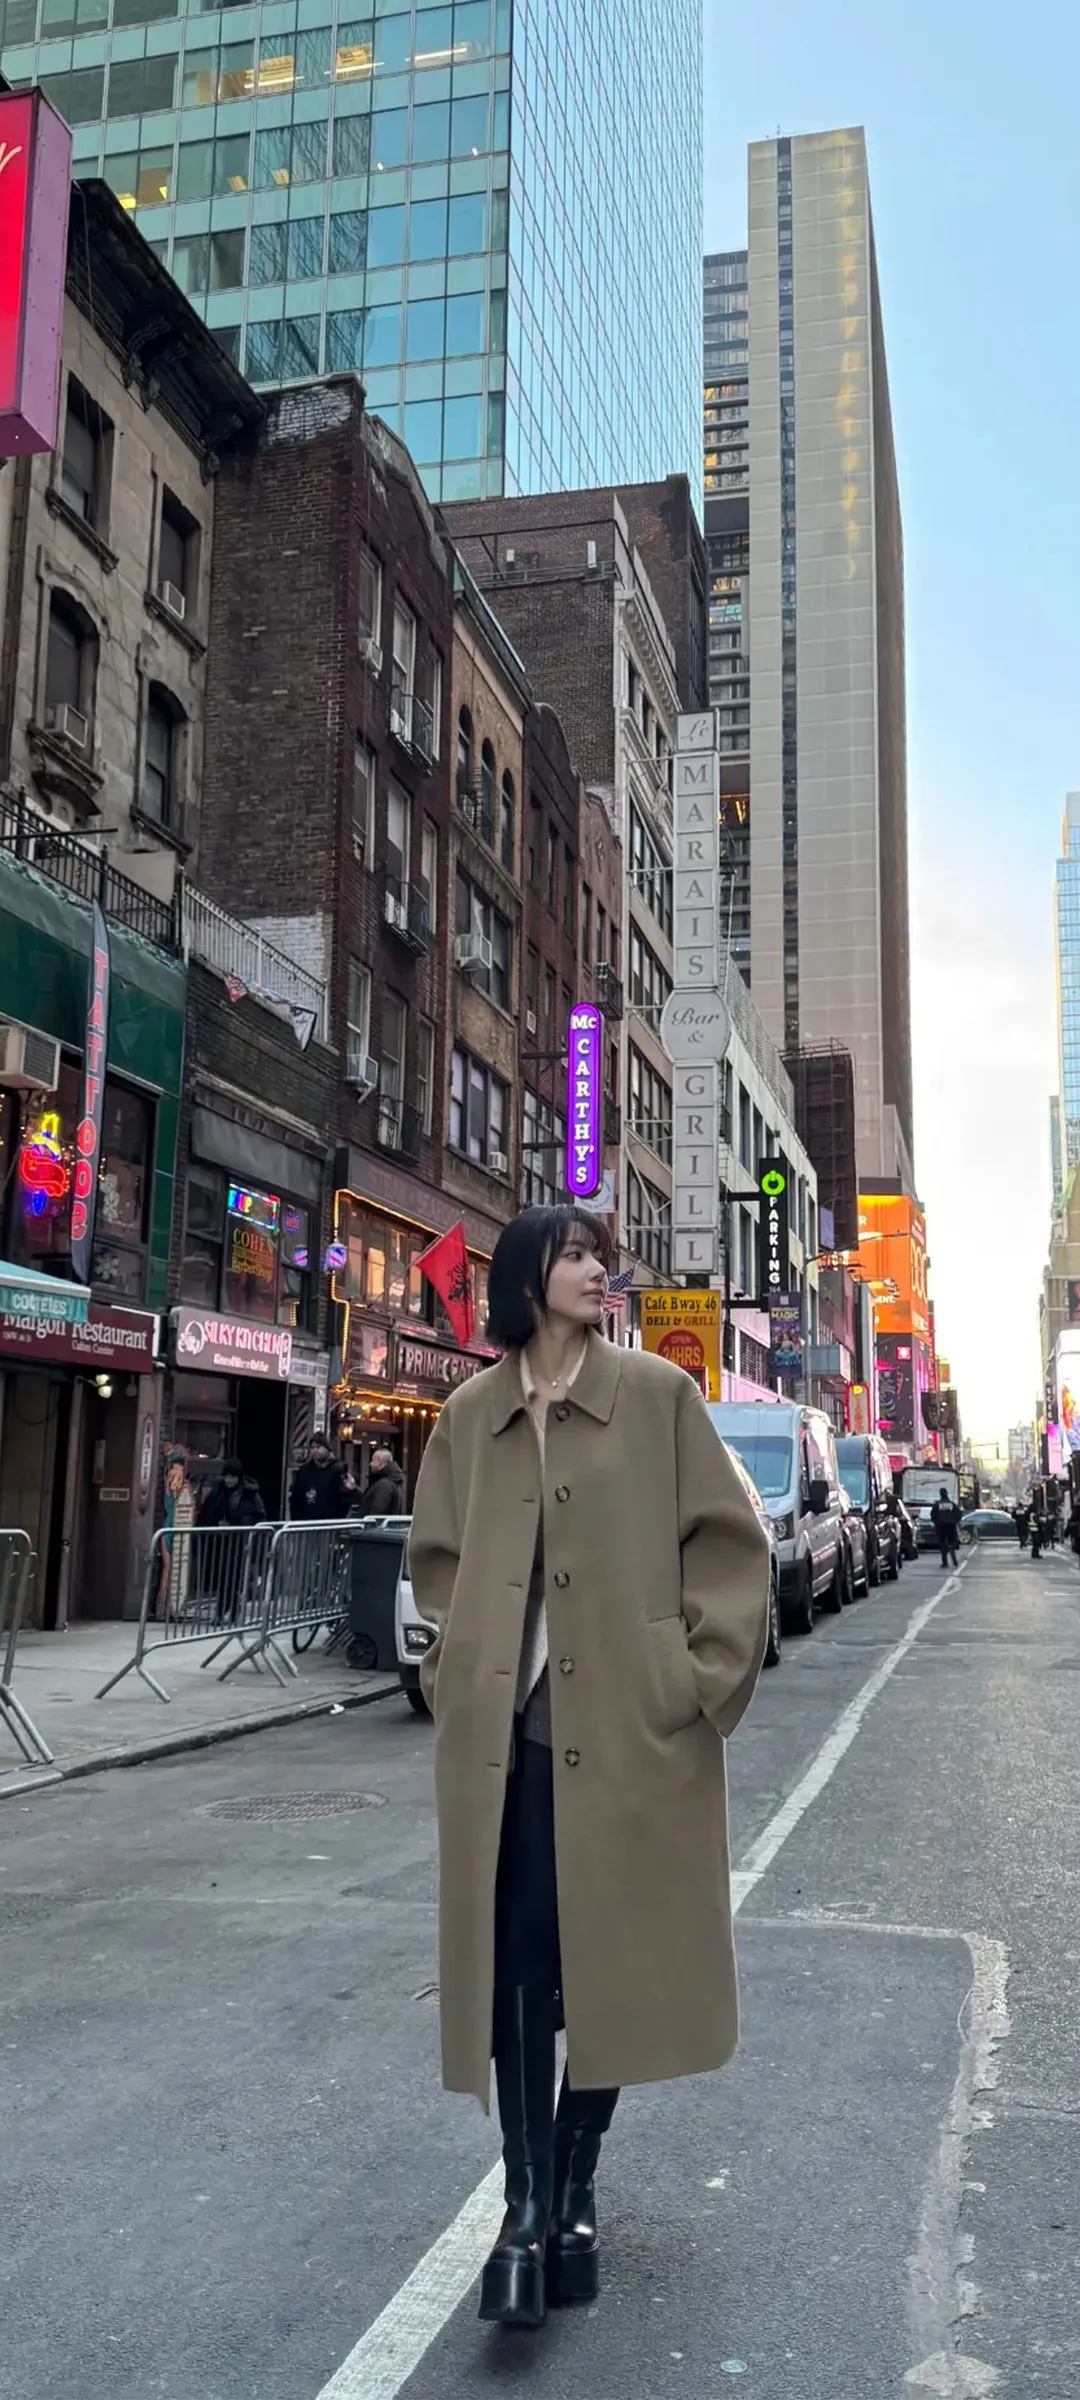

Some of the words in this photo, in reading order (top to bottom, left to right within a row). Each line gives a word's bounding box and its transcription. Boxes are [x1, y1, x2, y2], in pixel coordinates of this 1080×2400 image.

[680, 718, 709, 744] Le
[683, 762, 709, 976] MARAIS
[671, 1006, 720, 1027] Bar
[687, 1029, 704, 1044] &
[684, 1073, 706, 1262] GRILL
[768, 1196, 780, 1284] PARKING
[704, 1296, 717, 1310] 46
[646, 1316, 670, 1326] DELI
[673, 1316, 682, 1326] &
[684, 1316, 717, 1326] GRILL
[71, 1321, 148, 1350] Restaurant
[404, 1347, 444, 1379] PRIME
[663, 1345, 702, 1366] 24HRS
